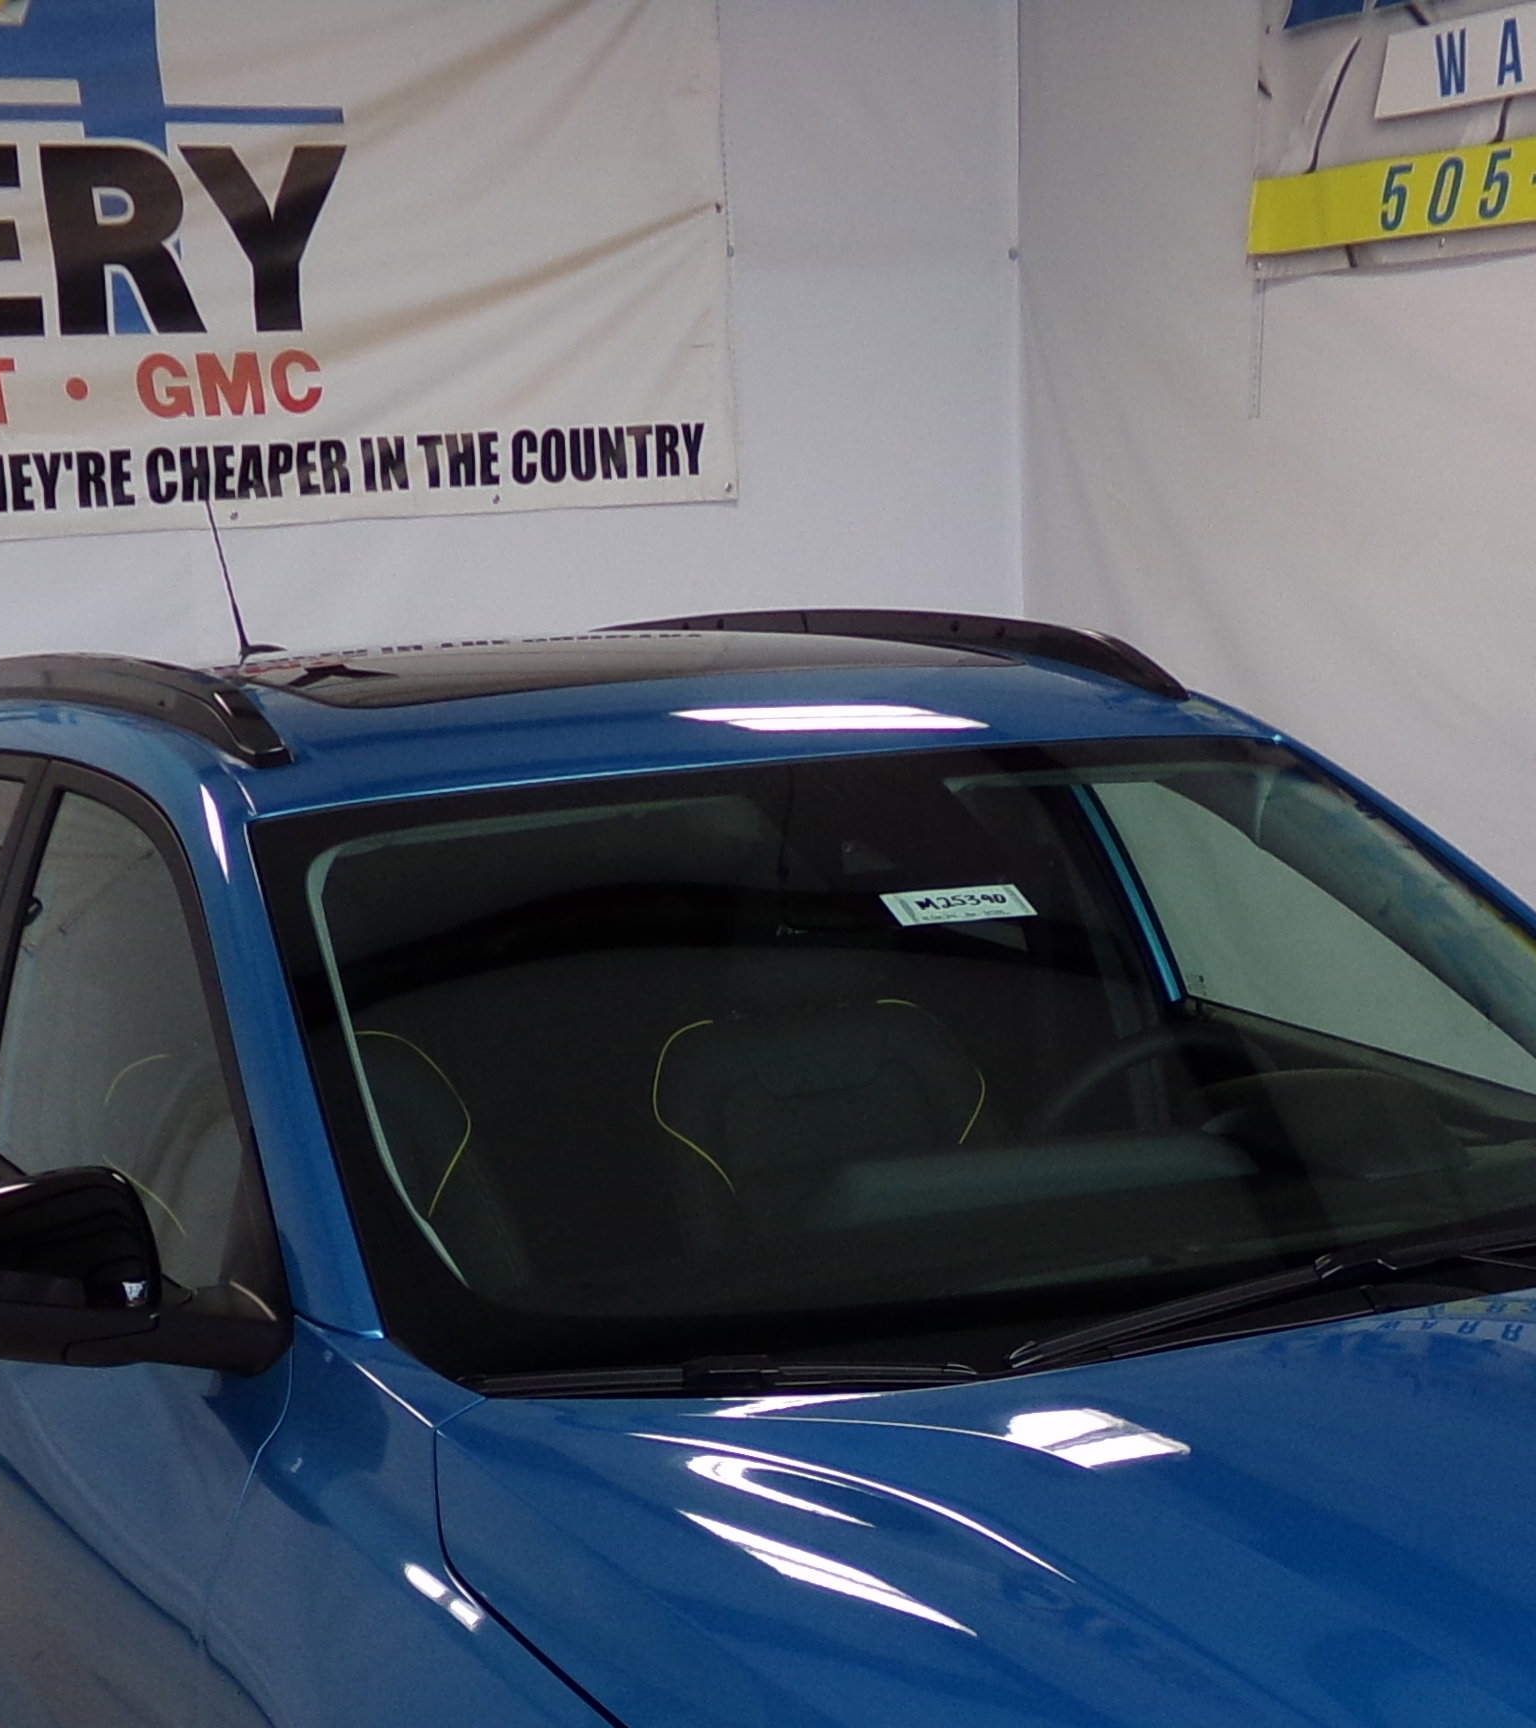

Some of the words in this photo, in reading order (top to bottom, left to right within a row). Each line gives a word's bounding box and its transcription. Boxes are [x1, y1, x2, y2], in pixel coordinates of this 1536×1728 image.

[134, 348, 324, 418] GMC
[145, 437, 350, 504] CHEAPER
[360, 435, 408, 492] IN
[417, 429, 501, 489] THE
[509, 421, 707, 484] COUNTRY
[914, 893, 1007, 911] M25390
